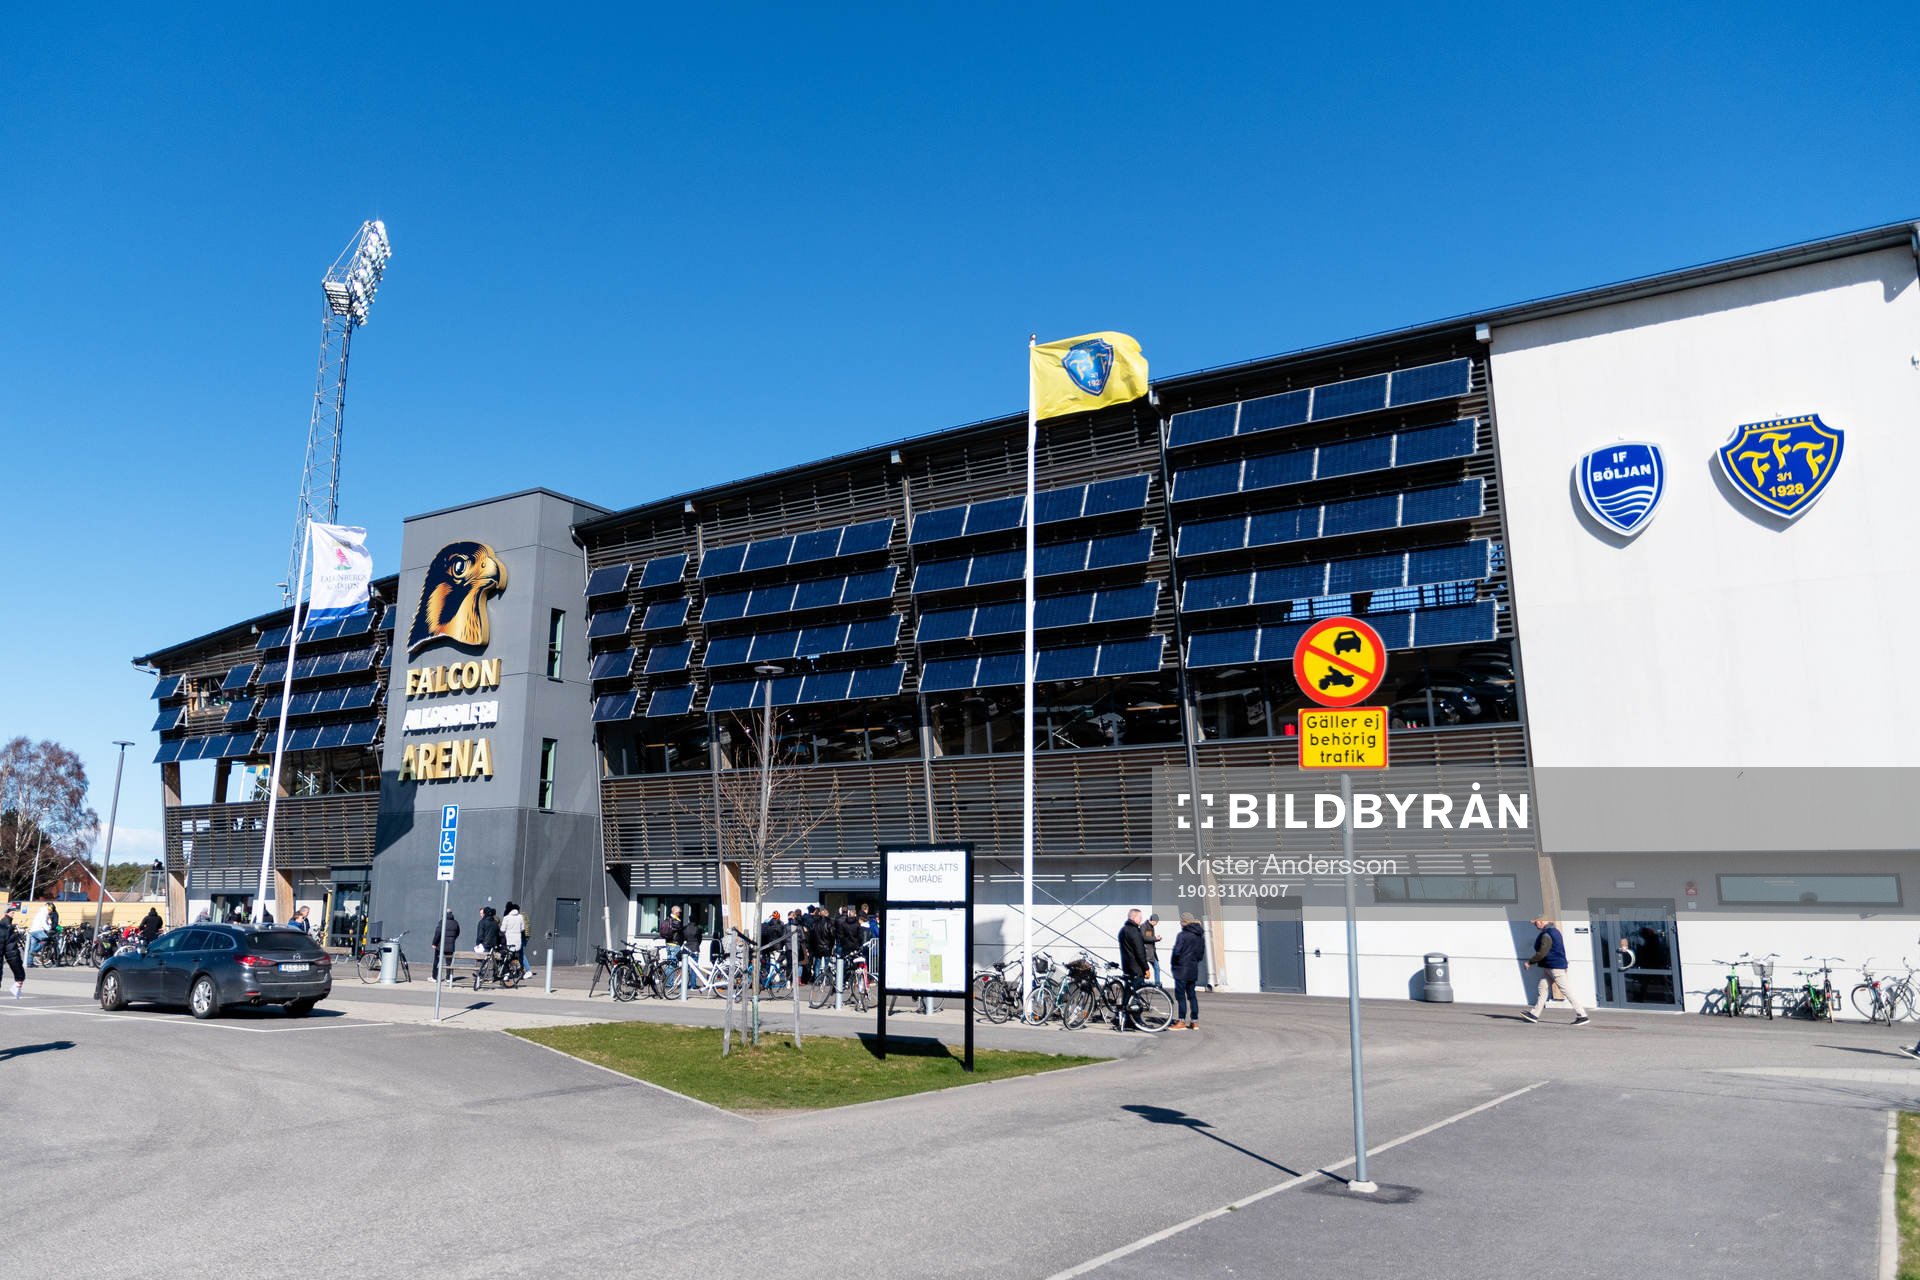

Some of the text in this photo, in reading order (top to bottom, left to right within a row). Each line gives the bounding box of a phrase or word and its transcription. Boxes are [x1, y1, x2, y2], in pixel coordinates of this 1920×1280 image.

[1612, 451, 1627, 463] IF
[1593, 464, 1652, 482] BÖLJAN
[1777, 472, 1792, 481] 3/1
[1769, 483, 1804, 497] 1928
[405, 658, 502, 695] FALCON
[1306, 714, 1379, 730] Gäller ej
[1310, 732, 1376, 748] behörig
[398, 738, 493, 781] ARENA
[1320, 749, 1365, 763] trafik
[445, 807, 456, 828] P
[908, 874, 943, 884] OMRÅDE
